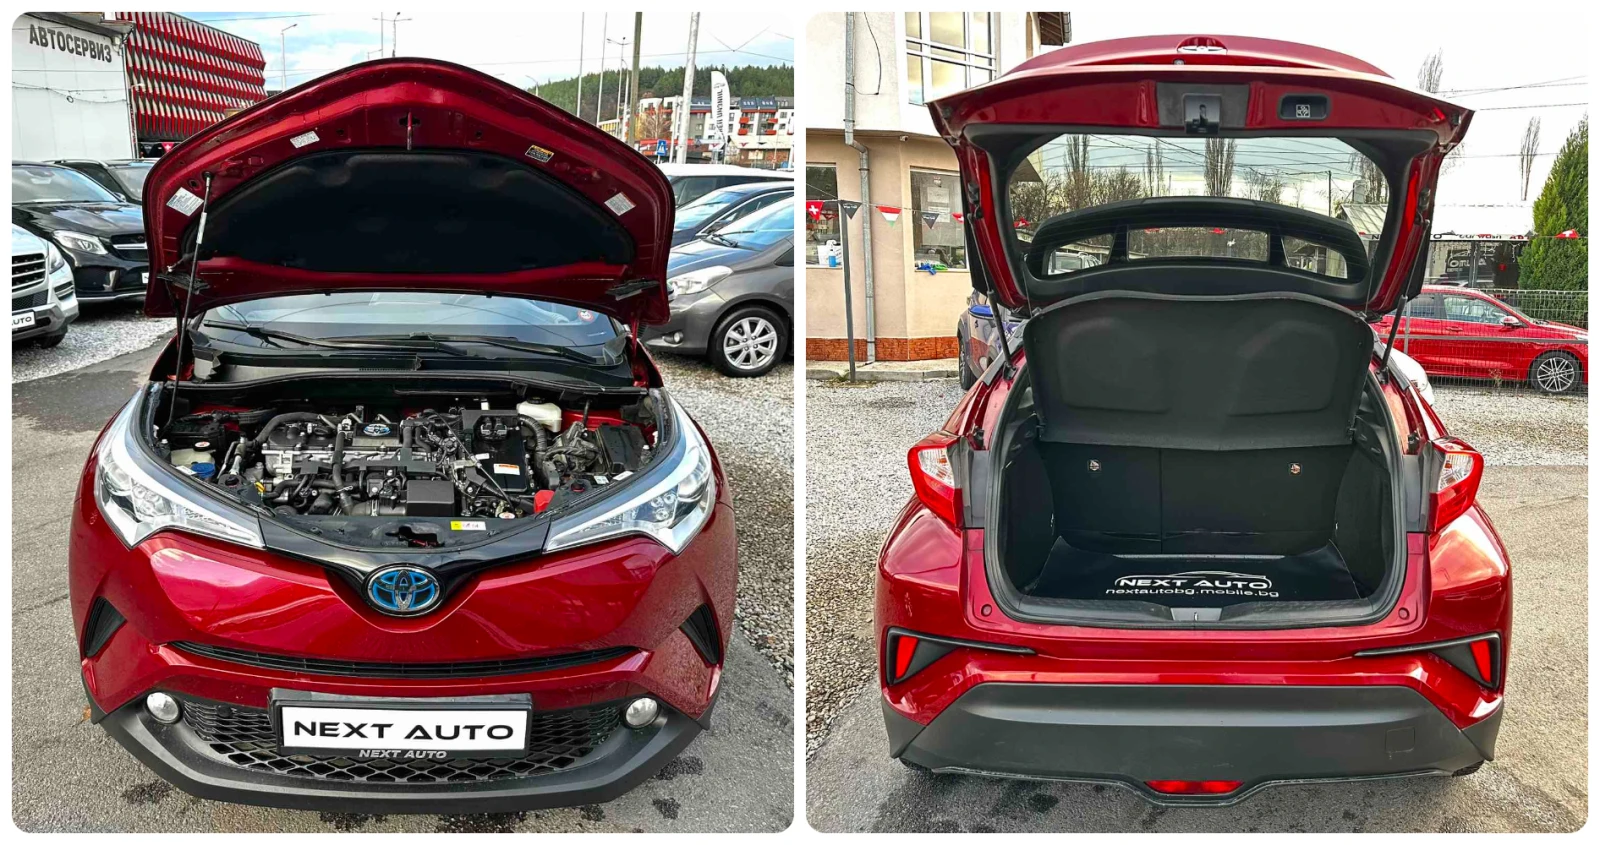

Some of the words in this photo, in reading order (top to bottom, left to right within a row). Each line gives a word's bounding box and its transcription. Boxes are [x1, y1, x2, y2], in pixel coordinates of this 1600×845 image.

[29, 23, 112, 63] АВТОСЕРВИЗ
[12, 316, 32, 326] UTO
[1119, 579, 1188, 587] NEXT
[1193, 579, 1268, 589] AUTO
[1105, 587, 1280, 598] nextautobg.mobile.bg
[294, 720, 394, 739] NEXT
[404, 724, 514, 741] AUTO
[358, 749, 402, 758] NEXT
[404, 750, 447, 759] AUTO
